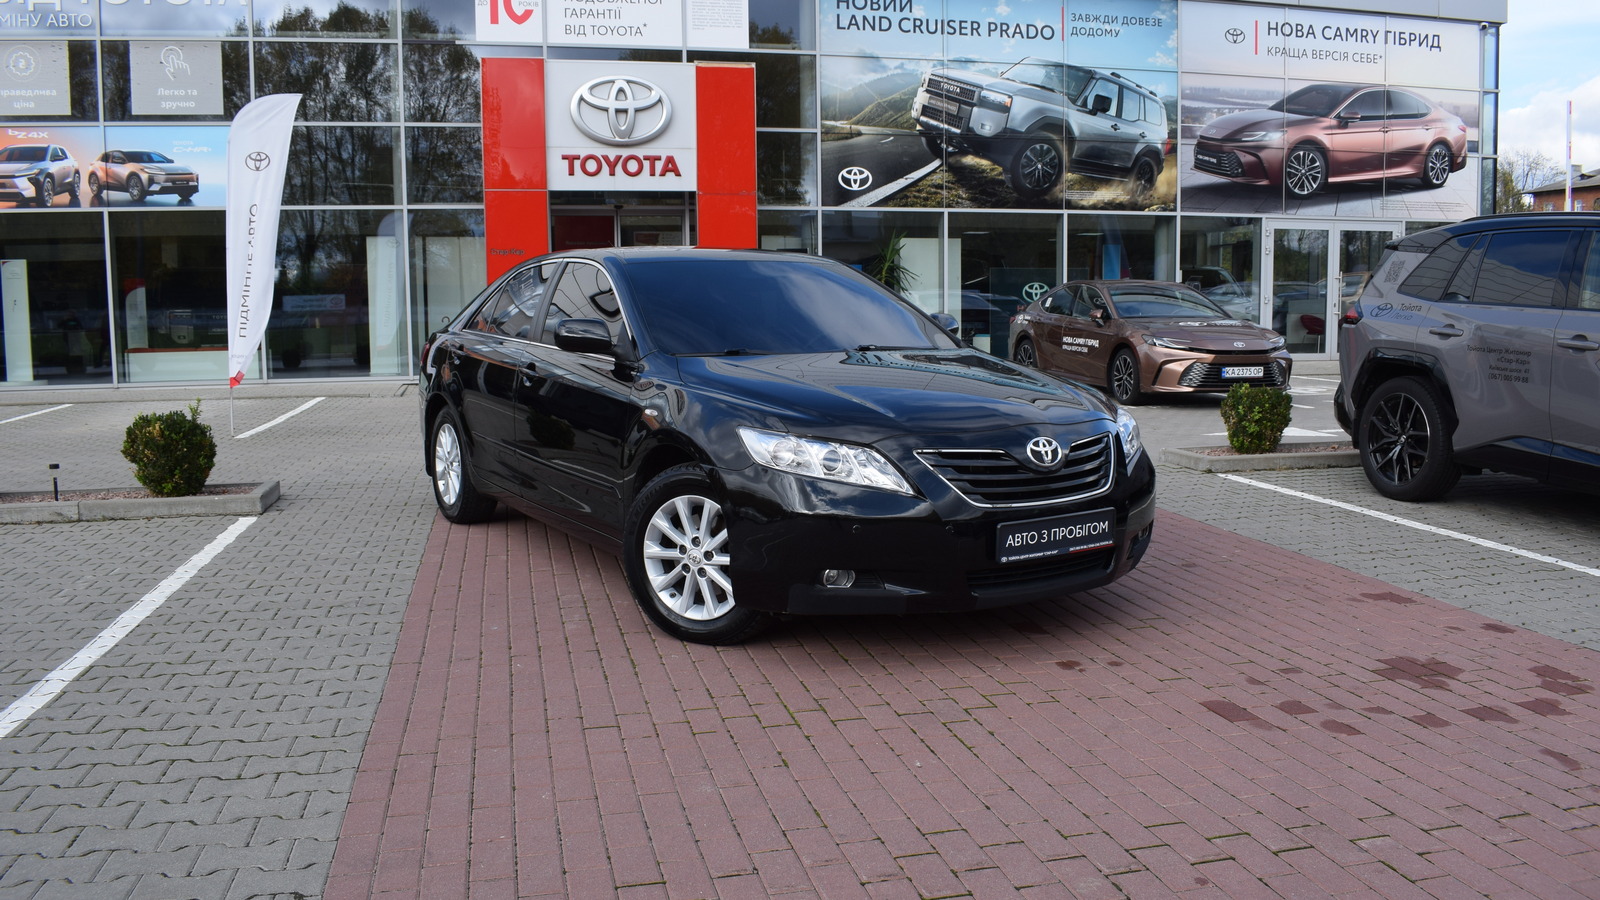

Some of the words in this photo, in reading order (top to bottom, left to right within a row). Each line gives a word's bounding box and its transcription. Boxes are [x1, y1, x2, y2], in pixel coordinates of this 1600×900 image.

[46, 13, 93, 27] АВТО
[564, 7, 622, 20] ГАРАНТІЇ
[1070, 12, 1119, 26] ЗАВЖДИ
[1121, 15, 1163, 28] ДОВЕЗЕ
[564, 24, 587, 37] ВІД
[836, 13, 892, 32] LAND
[898, 17, 982, 37] CRUISER
[988, 22, 1055, 41] PRADO
[1070, 26, 1121, 39] ДОДОМУ
[1267, 21, 1315, 40] НОВА
[1321, 25, 1380, 44] CAMRY
[1384, 30, 1442, 52] ГІБРИД
[1267, 46, 1308, 60] КРАЩА
[1311, 49, 1349, 62] ВЕРСІЯ
[157, 88, 186, 96] Легко
[940, 82, 960, 93] TOYOTA
[14, 99, 36, 110] ціна
[160, 101, 196, 110] зручно
[561, 154, 682, 177] TOYOTA
[1399, 303, 1423, 312] Тойота
[1236, 368, 1253, 376] 2375
[1005, 531, 1038, 548] АВТО
[1040, 530, 1048, 543] З
[1050, 520, 1109, 541] ПРОБІГОМ
